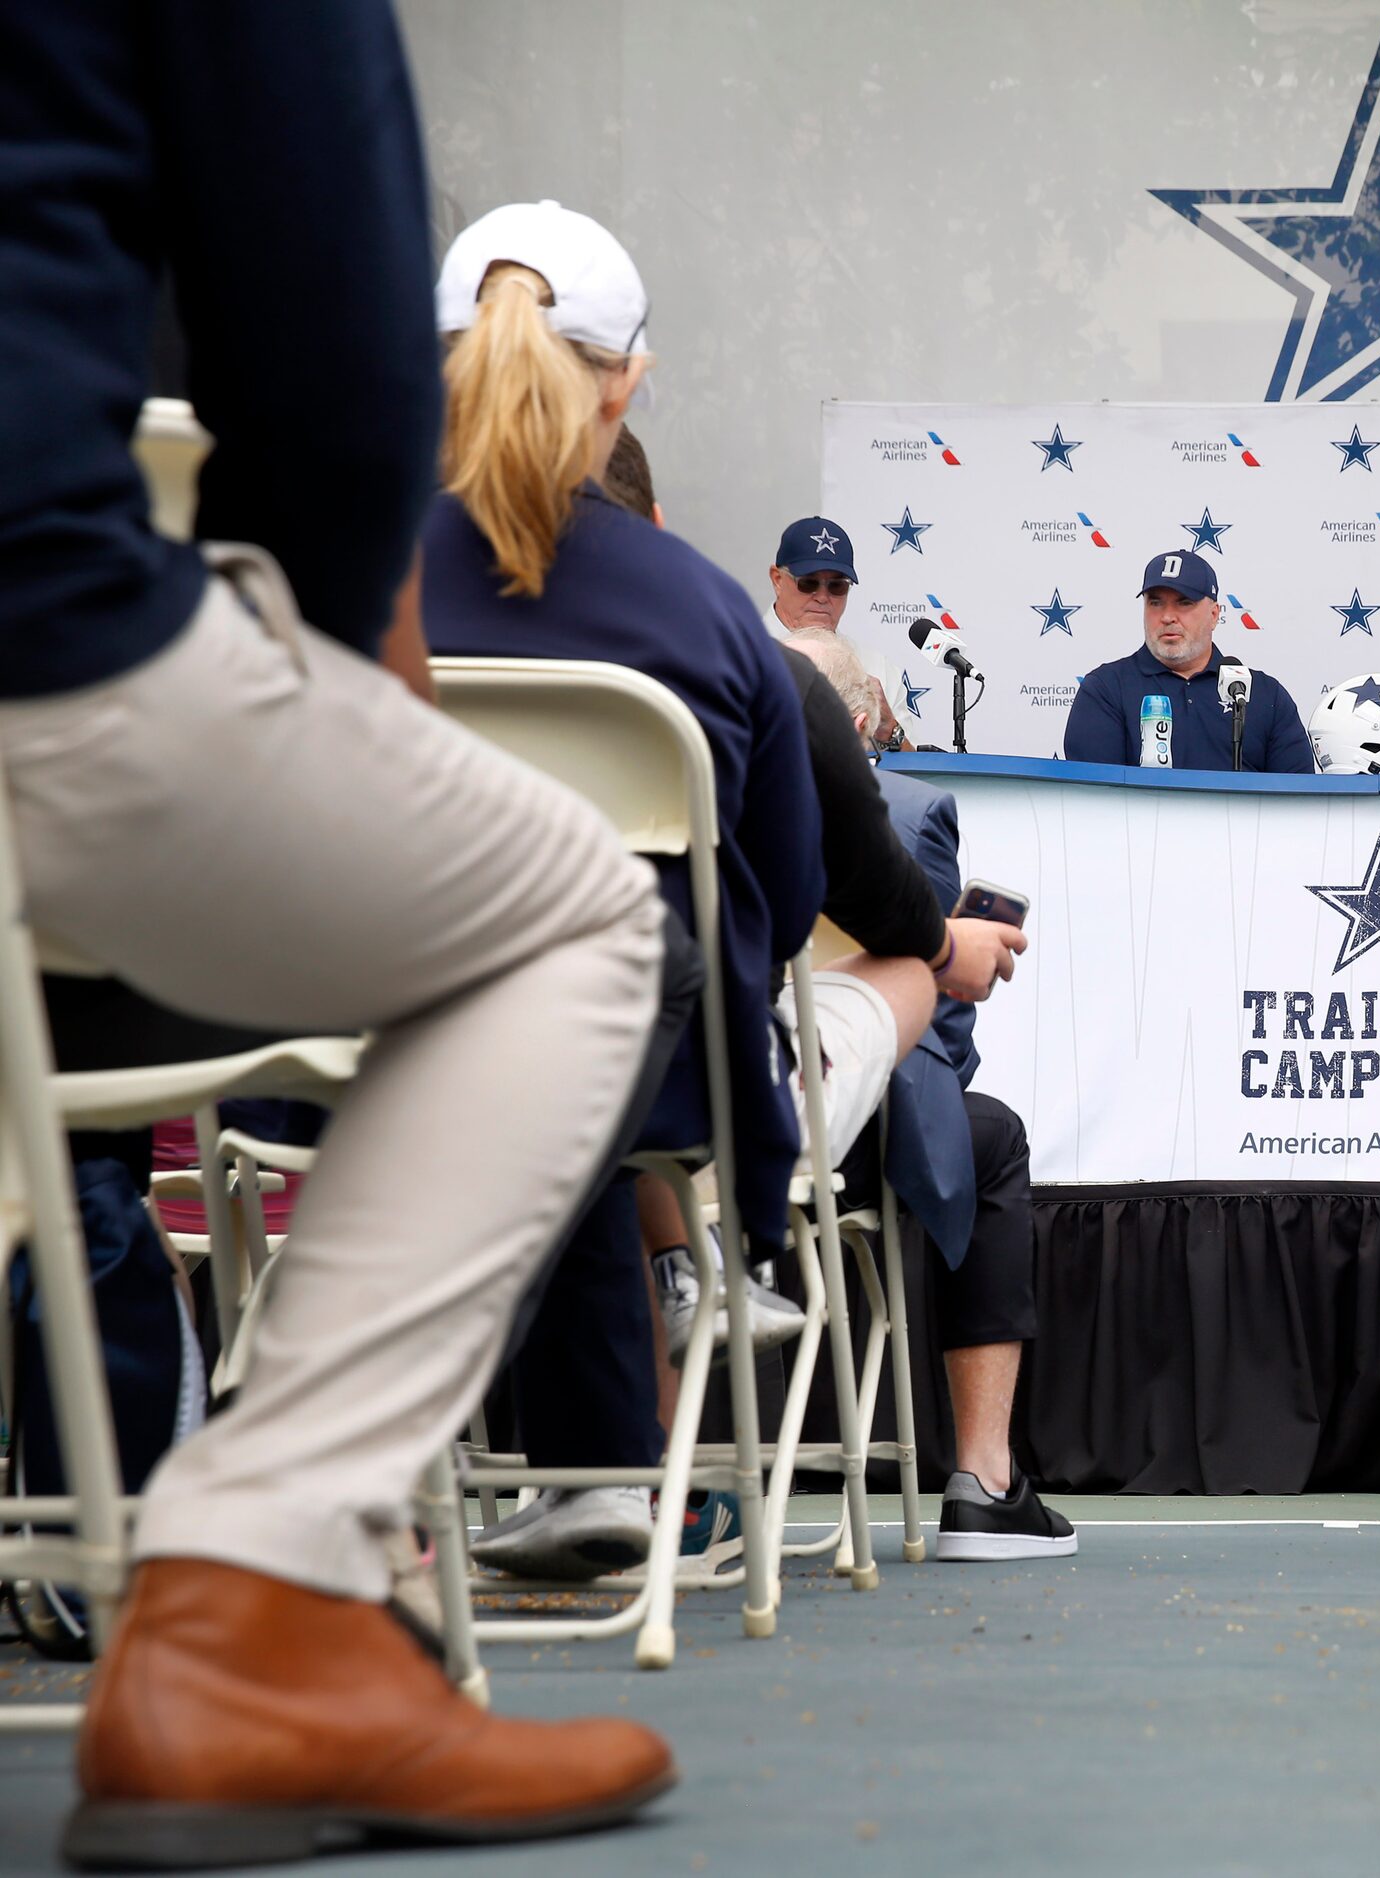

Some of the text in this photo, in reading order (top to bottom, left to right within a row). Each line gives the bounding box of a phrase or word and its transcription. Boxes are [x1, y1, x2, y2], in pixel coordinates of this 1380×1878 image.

[871, 440, 927, 451] American
[1172, 441, 1228, 451] American
[882, 451, 927, 461] Airlines
[1182, 452, 1227, 462] Airlines
[1021, 520, 1077, 531] American
[1321, 520, 1376, 531] American
[1032, 532, 1077, 542] Airlines
[1332, 532, 1376, 542] Airlines
[1161, 555, 1183, 579] D
[870, 602, 926, 612] American
[1020, 685, 1076, 696] American
[1156, 720, 1169, 765] core
[1240, 1049, 1380, 1099] CAMP
[1239, 1131, 1362, 1155] American
